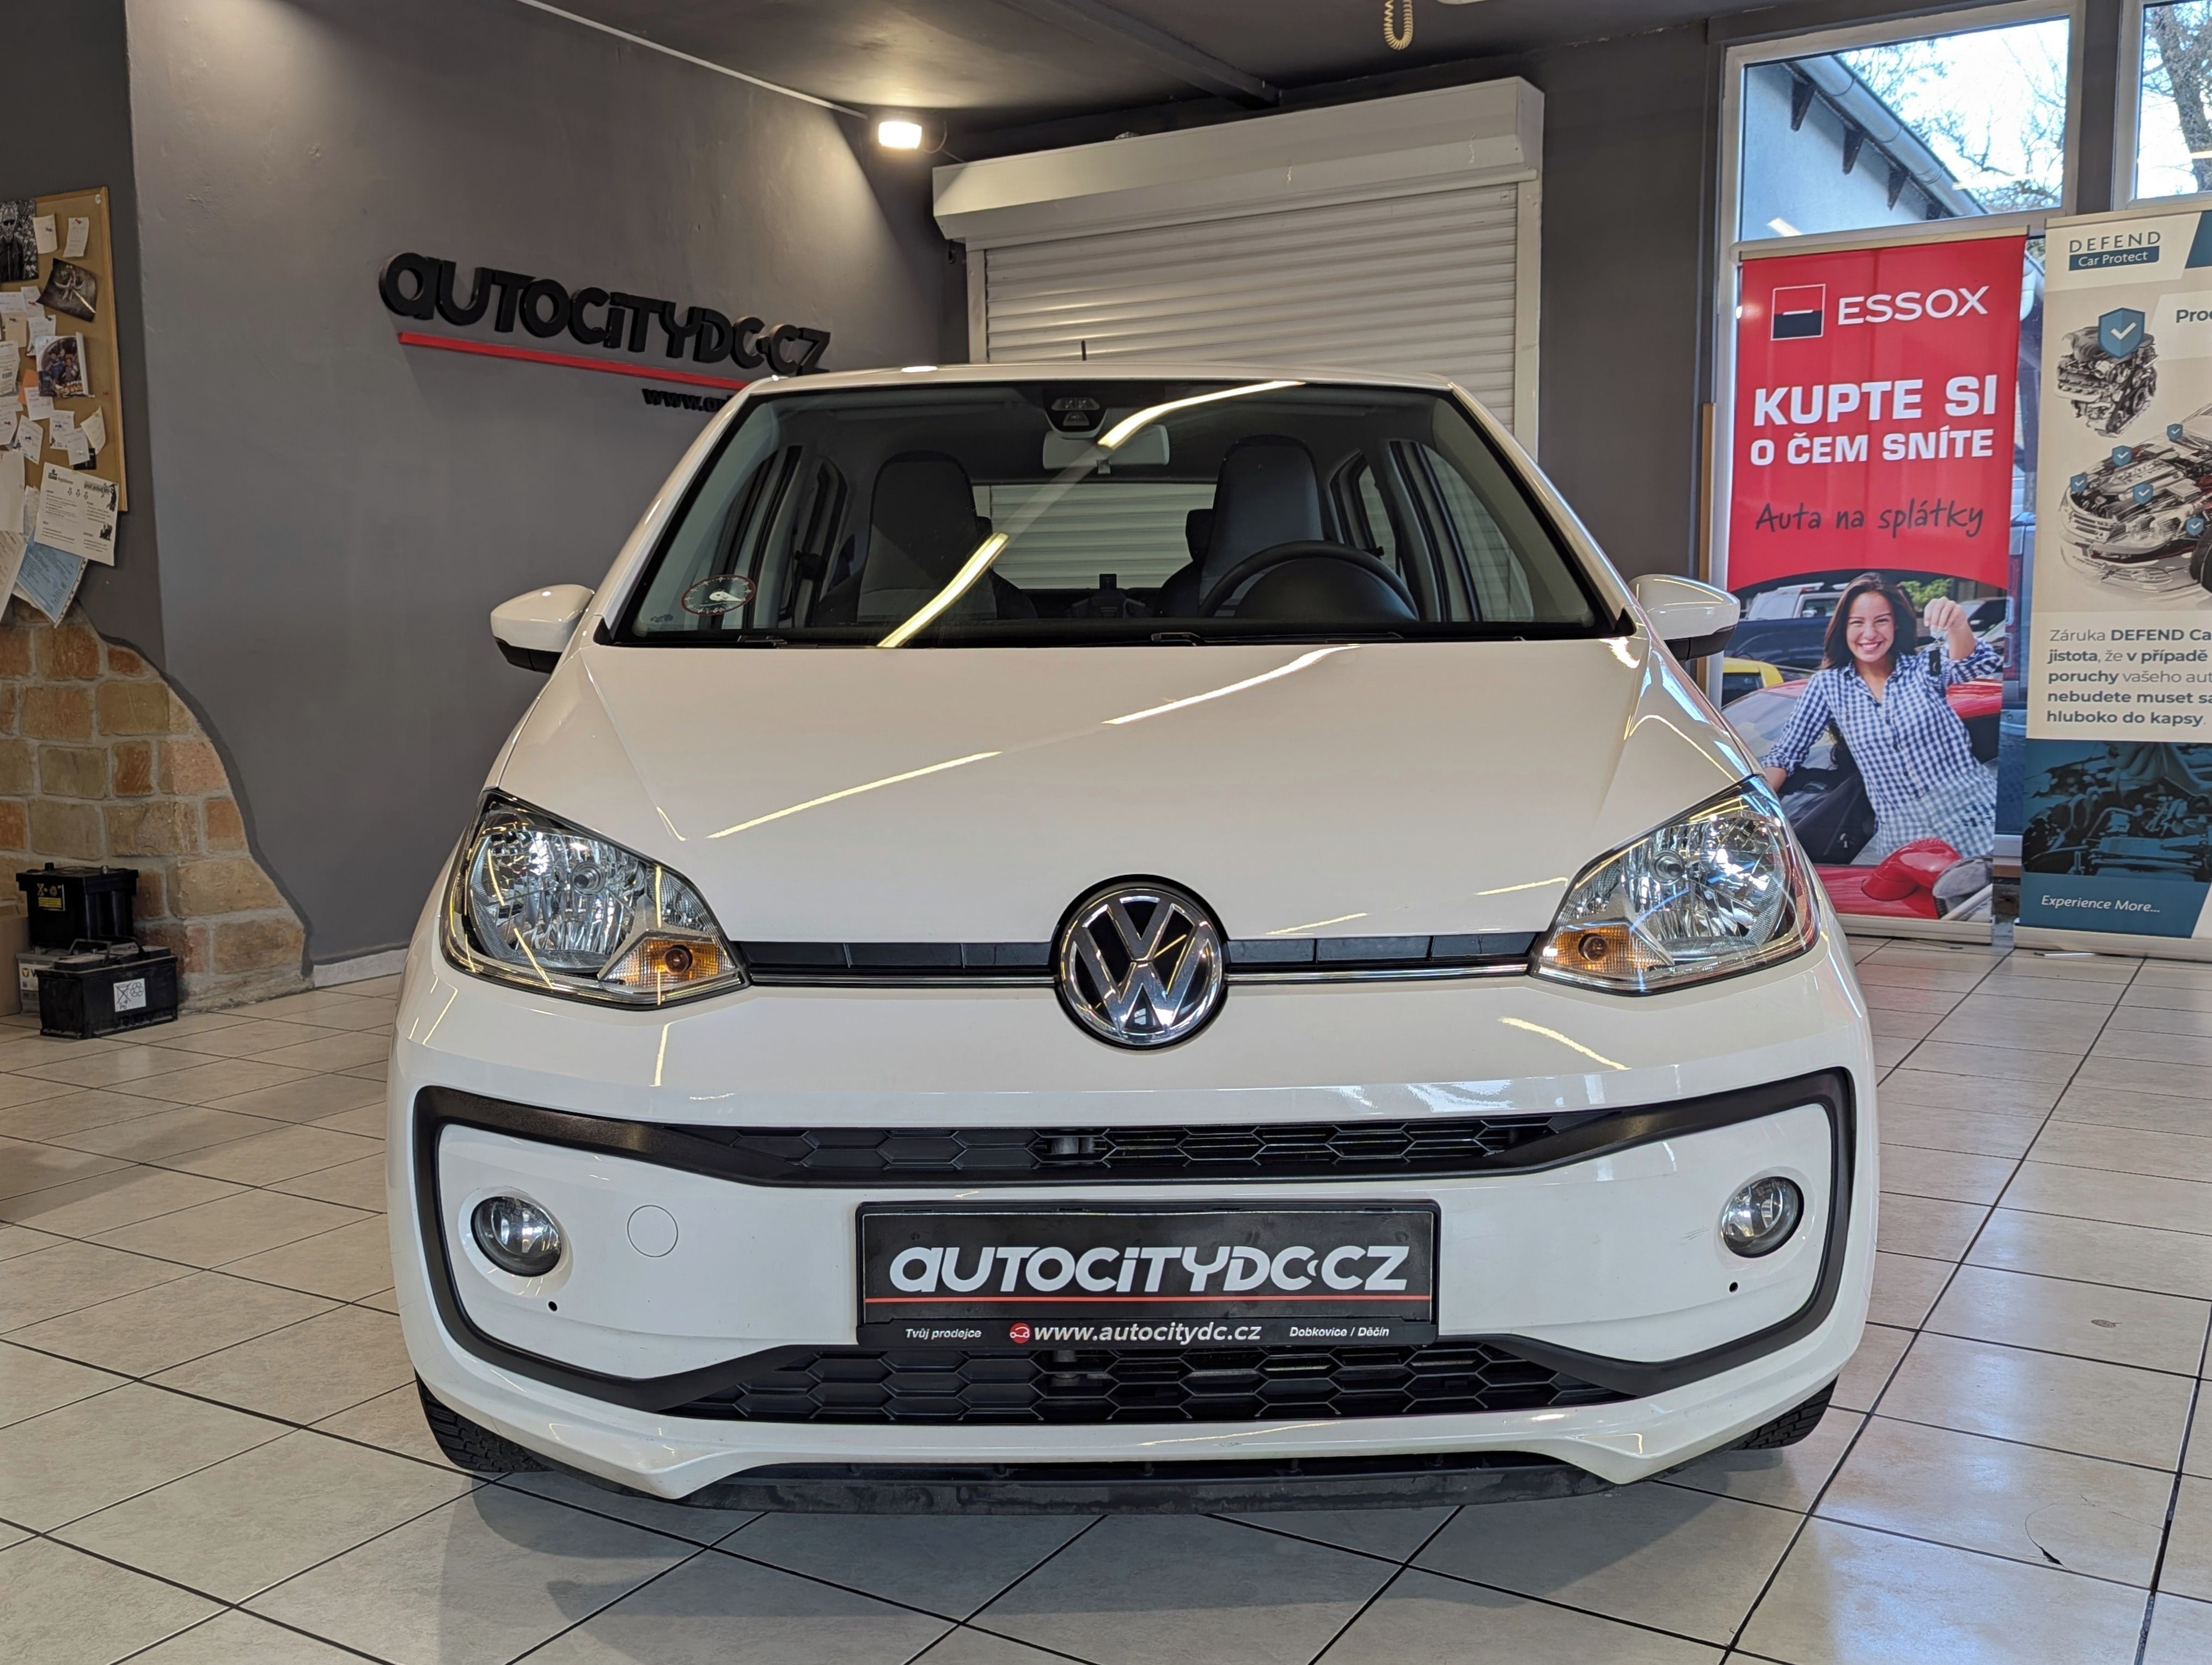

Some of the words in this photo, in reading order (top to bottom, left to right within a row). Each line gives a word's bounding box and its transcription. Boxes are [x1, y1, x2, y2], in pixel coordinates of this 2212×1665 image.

[2069, 231, 2161, 253] DEFEND
[2078, 255, 2099, 267] Car
[2101, 250, 2148, 265] Protect
[1838, 285, 1990, 326] ESSOX
[1753, 379, 1924, 426] KUPTE
[1945, 374, 1998, 417] SI
[1750, 439, 1775, 466] O
[1787, 432, 1868, 464] ČEM
[1882, 425, 1994, 461] SNÍTE
[1755, 501, 1823, 533] Auta
[1835, 511, 1865, 529] na
[1877, 498, 1984, 539] splátky
[2049, 629, 2106, 641] Záruka
[2111, 629, 2184, 641] DEFEND
[2047, 649, 2102, 664] jistota,
[2104, 650, 2123, 662] že
[2126, 652, 2138, 662] v
[2140, 648, 2208, 664] případě
[2048, 670, 2119, 684] poruchy
[2122, 670, 2182, 683] vašeho
[2047, 690, 2131, 703] nebudete
[2136, 692, 2193, 703] muset
[2046, 710, 2118, 724] hluboko
[2122, 711, 2146, 724] do
[2040, 895, 2112, 910] Experience
[1062, 889, 1221, 1044] VW
[905, 1327, 930, 1340] Tvůj
[931, 1328, 982, 1340] prodejce
[1034, 1321, 1262, 1345] www.autocitydc.cz
[1289, 1326, 1348, 1337] Dobkovice
[1349, 1327, 1355, 1337] /
[1357, 1326, 1390, 1337] Děčín
